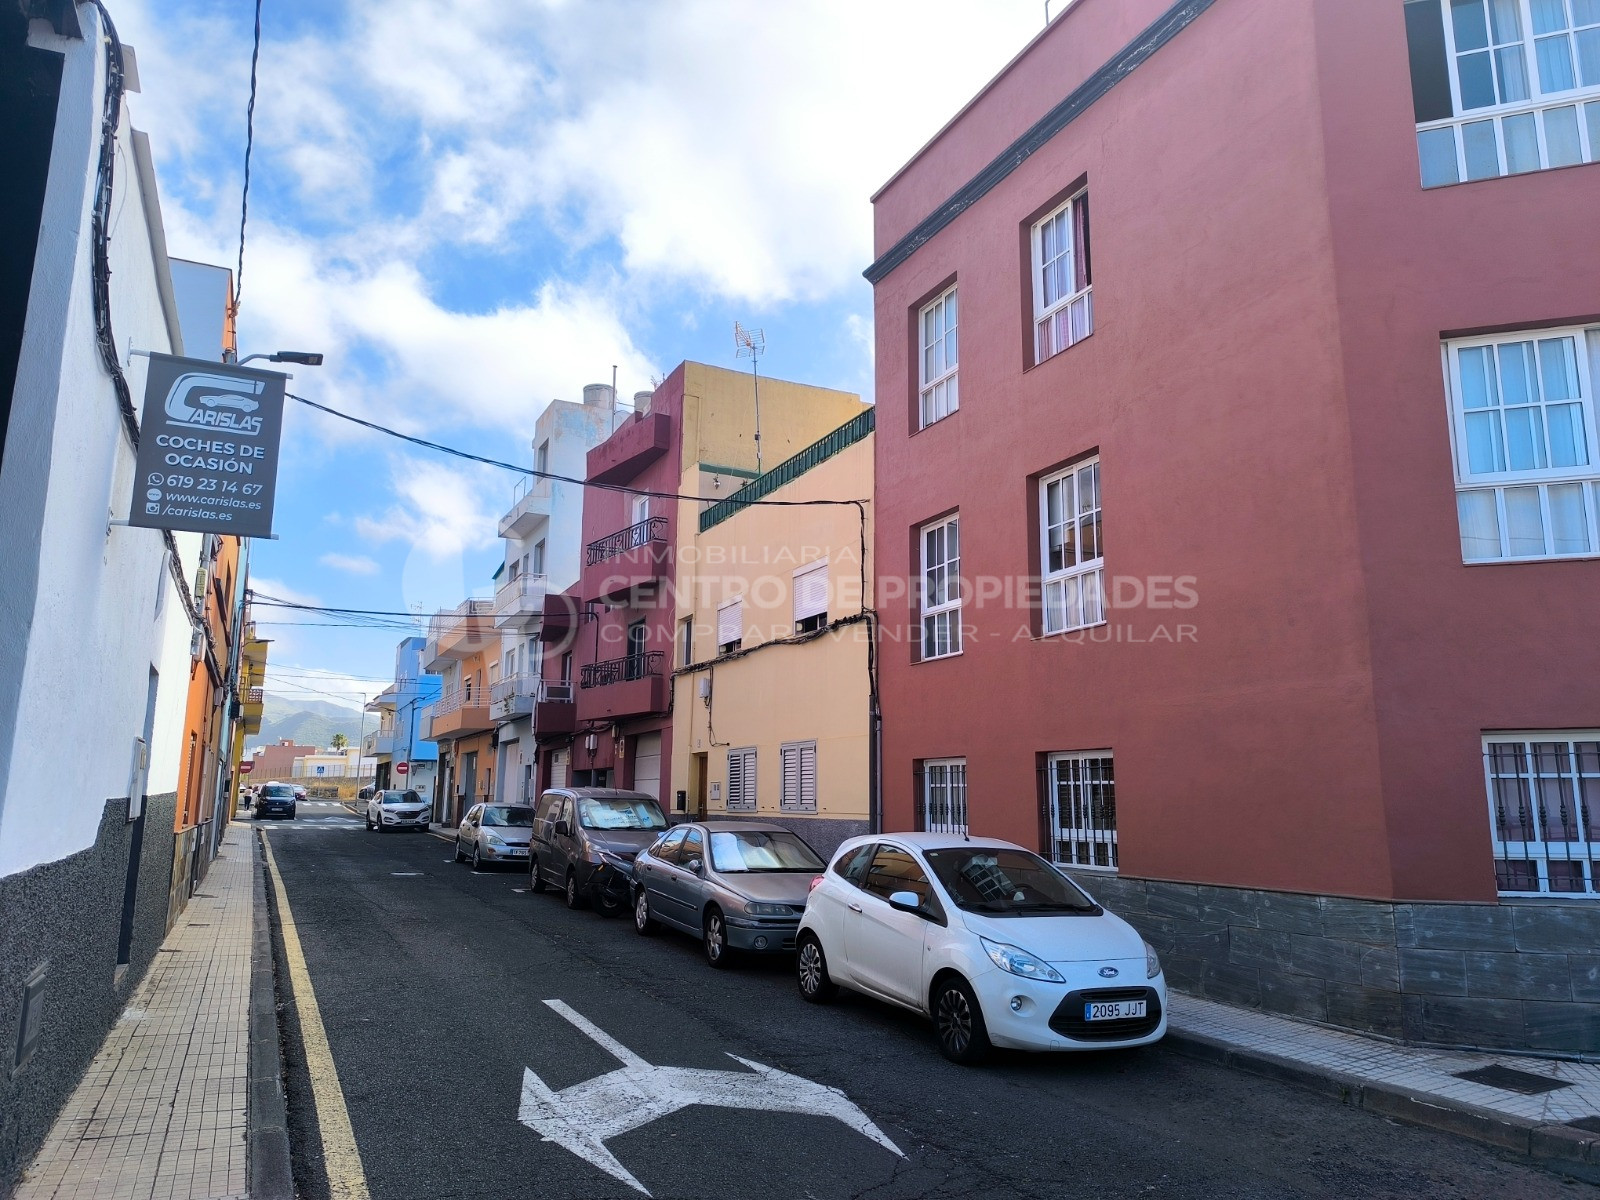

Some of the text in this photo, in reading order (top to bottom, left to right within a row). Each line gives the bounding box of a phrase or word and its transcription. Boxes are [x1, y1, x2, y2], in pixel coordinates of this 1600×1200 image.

[156, 434, 265, 459] COCHES DE
[164, 453, 253, 475] OCASIÓN
[166, 474, 263, 496] 619 23 14 67
[166, 492, 262, 510] www.carislas.es
[162, 504, 233, 521] /carislas.es
[1092, 1002, 1144, 1018] 2095 JJT
